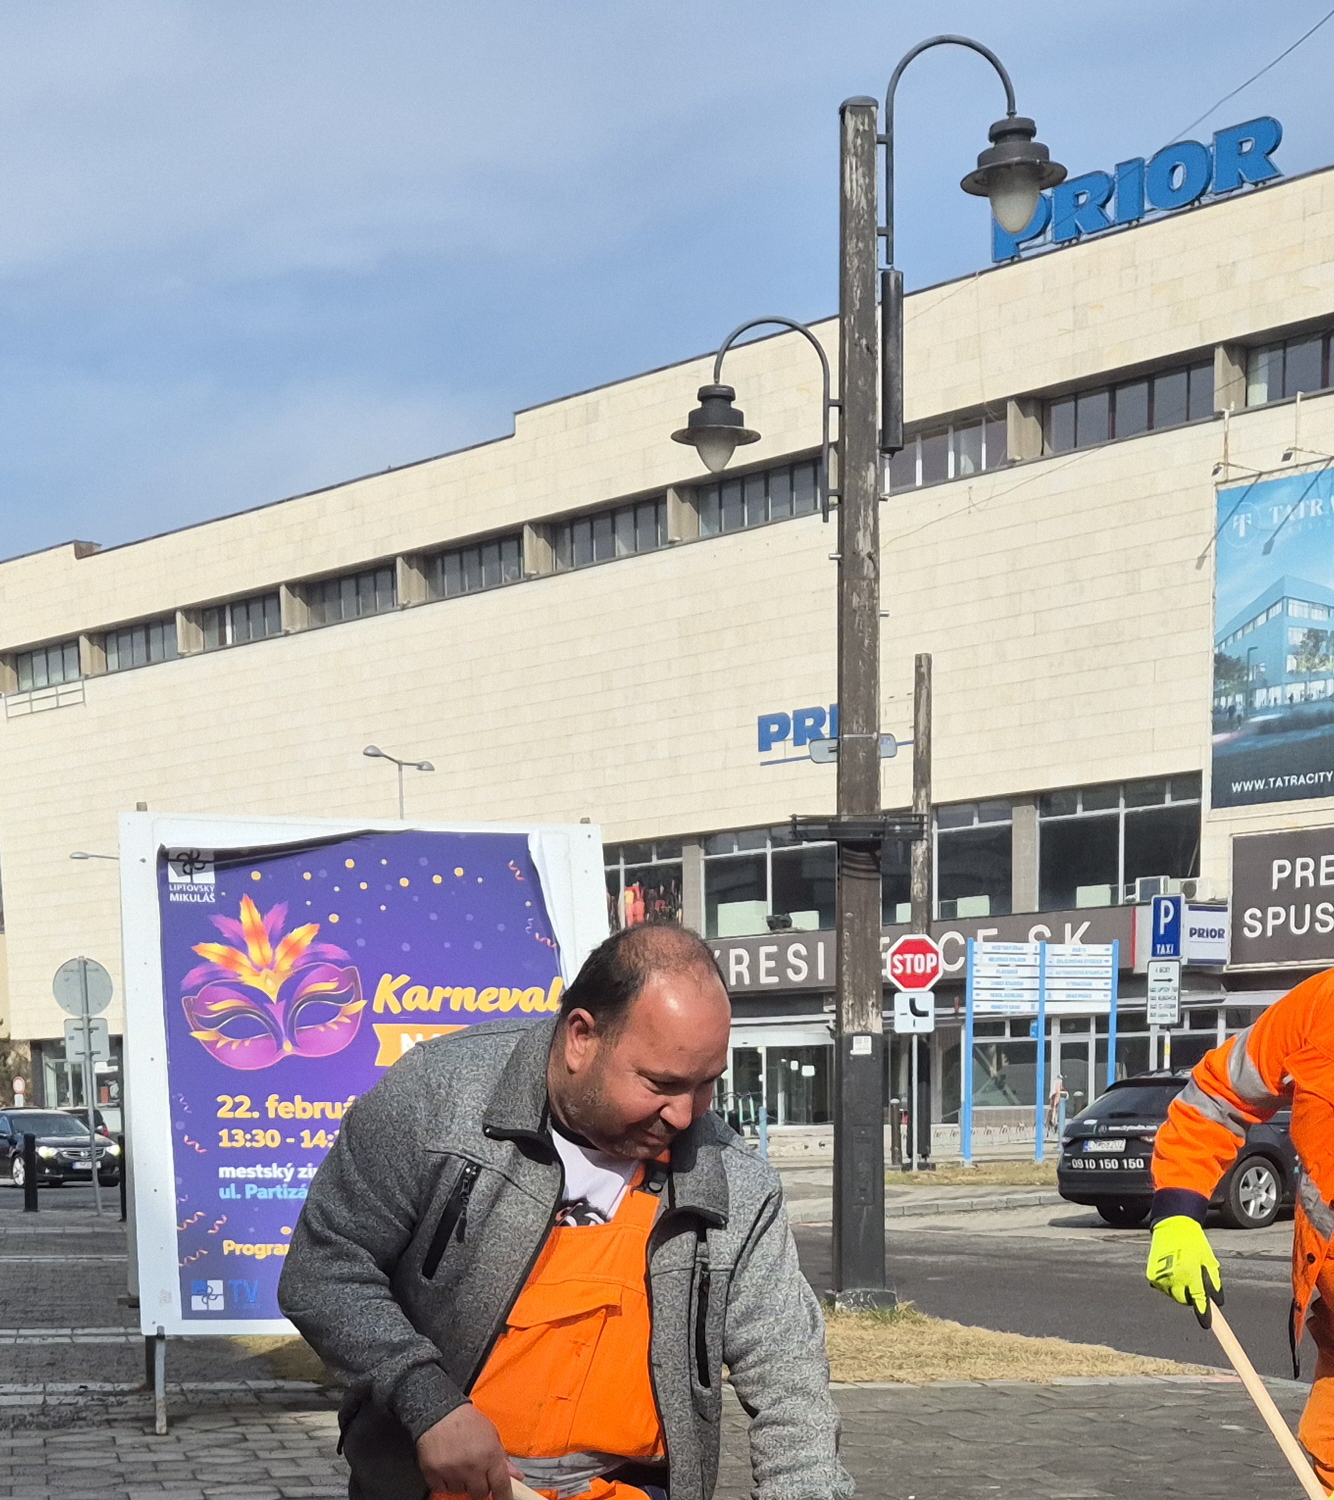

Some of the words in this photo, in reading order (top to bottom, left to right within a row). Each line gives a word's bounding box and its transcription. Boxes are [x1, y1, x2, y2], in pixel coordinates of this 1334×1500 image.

[992, 116, 1284, 263] PRIOR
[169, 892, 216, 903] MIKULÁŠ
[1160, 899, 1175, 935] P
[1189, 927, 1225, 939] PRIOR
[1156, 943, 1174, 955] TAXI
[892, 952, 938, 975] STOP
[372, 973, 564, 1015] Karneval
[217, 1095, 260, 1118] 22.
[218, 1129, 282, 1148] 13:30
[300, 1129, 340, 1148] 14:
[218, 1163, 295, 1182] mestský
[1072, 1158, 1096, 1169] 0910
[1122, 1158, 1145, 1169] 150
[219, 1183, 241, 1199] ul.
[229, 1280, 260, 1303] TV
